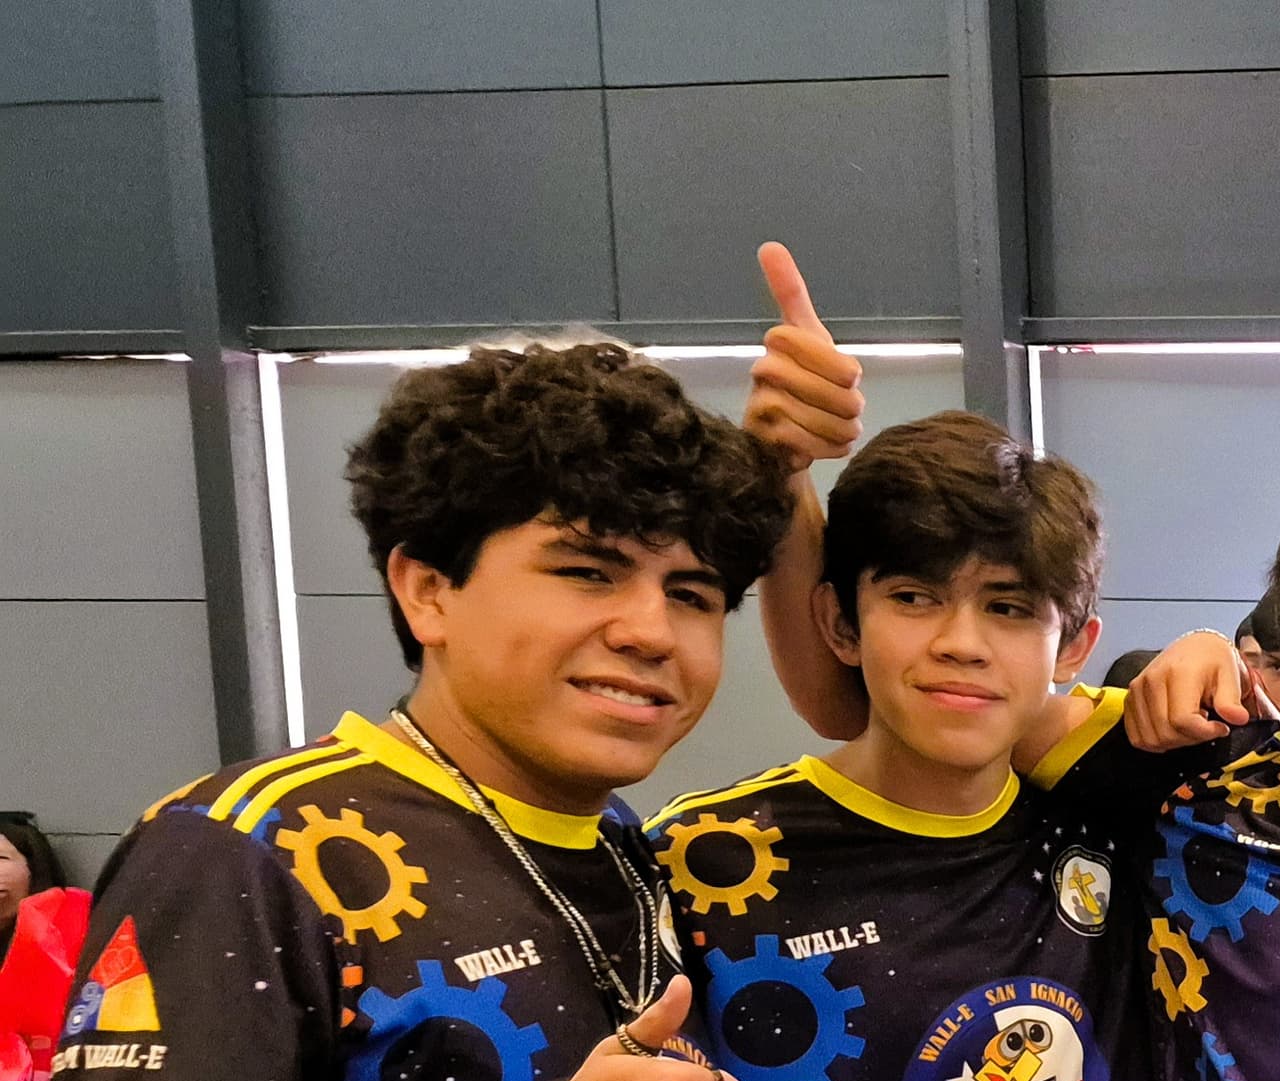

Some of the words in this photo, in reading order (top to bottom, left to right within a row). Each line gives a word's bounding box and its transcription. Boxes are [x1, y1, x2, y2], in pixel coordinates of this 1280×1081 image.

[454, 939, 542, 982] WALL-E
[785, 921, 881, 960] WALL-E
[918, 1003, 975, 1062] WALL-E
[985, 984, 1017, 1006] SAN
[1030, 983, 1084, 1022] IGNACIO
[84, 1044, 168, 1069] WALL-E
